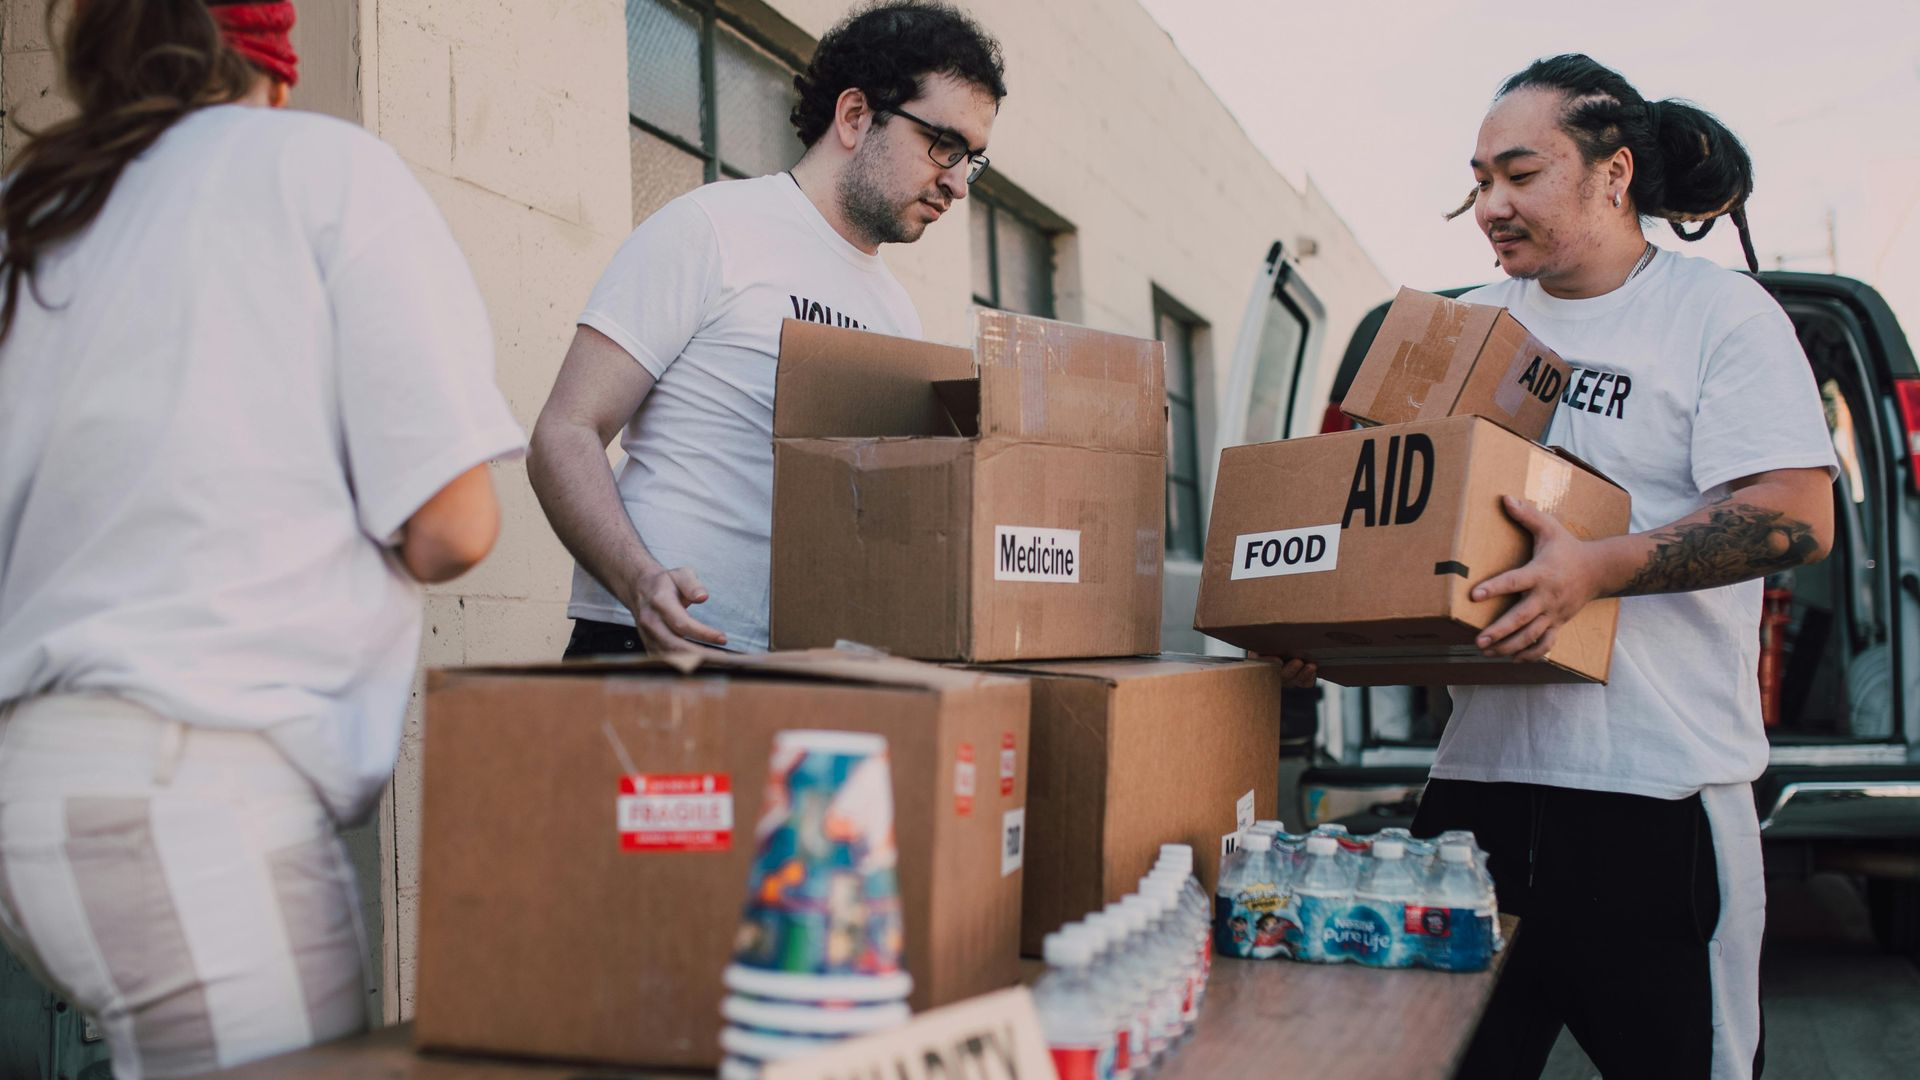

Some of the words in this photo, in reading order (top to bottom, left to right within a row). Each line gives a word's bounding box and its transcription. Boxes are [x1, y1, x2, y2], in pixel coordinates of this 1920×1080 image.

[1518, 355, 1562, 403] AID
[1341, 433, 1435, 529] AID
[1000, 533, 1074, 576] Medicine
[1244, 534, 1327, 570] FOOD
[1322, 927, 1362, 944] Pure
[1363, 932, 1390, 953] Life
